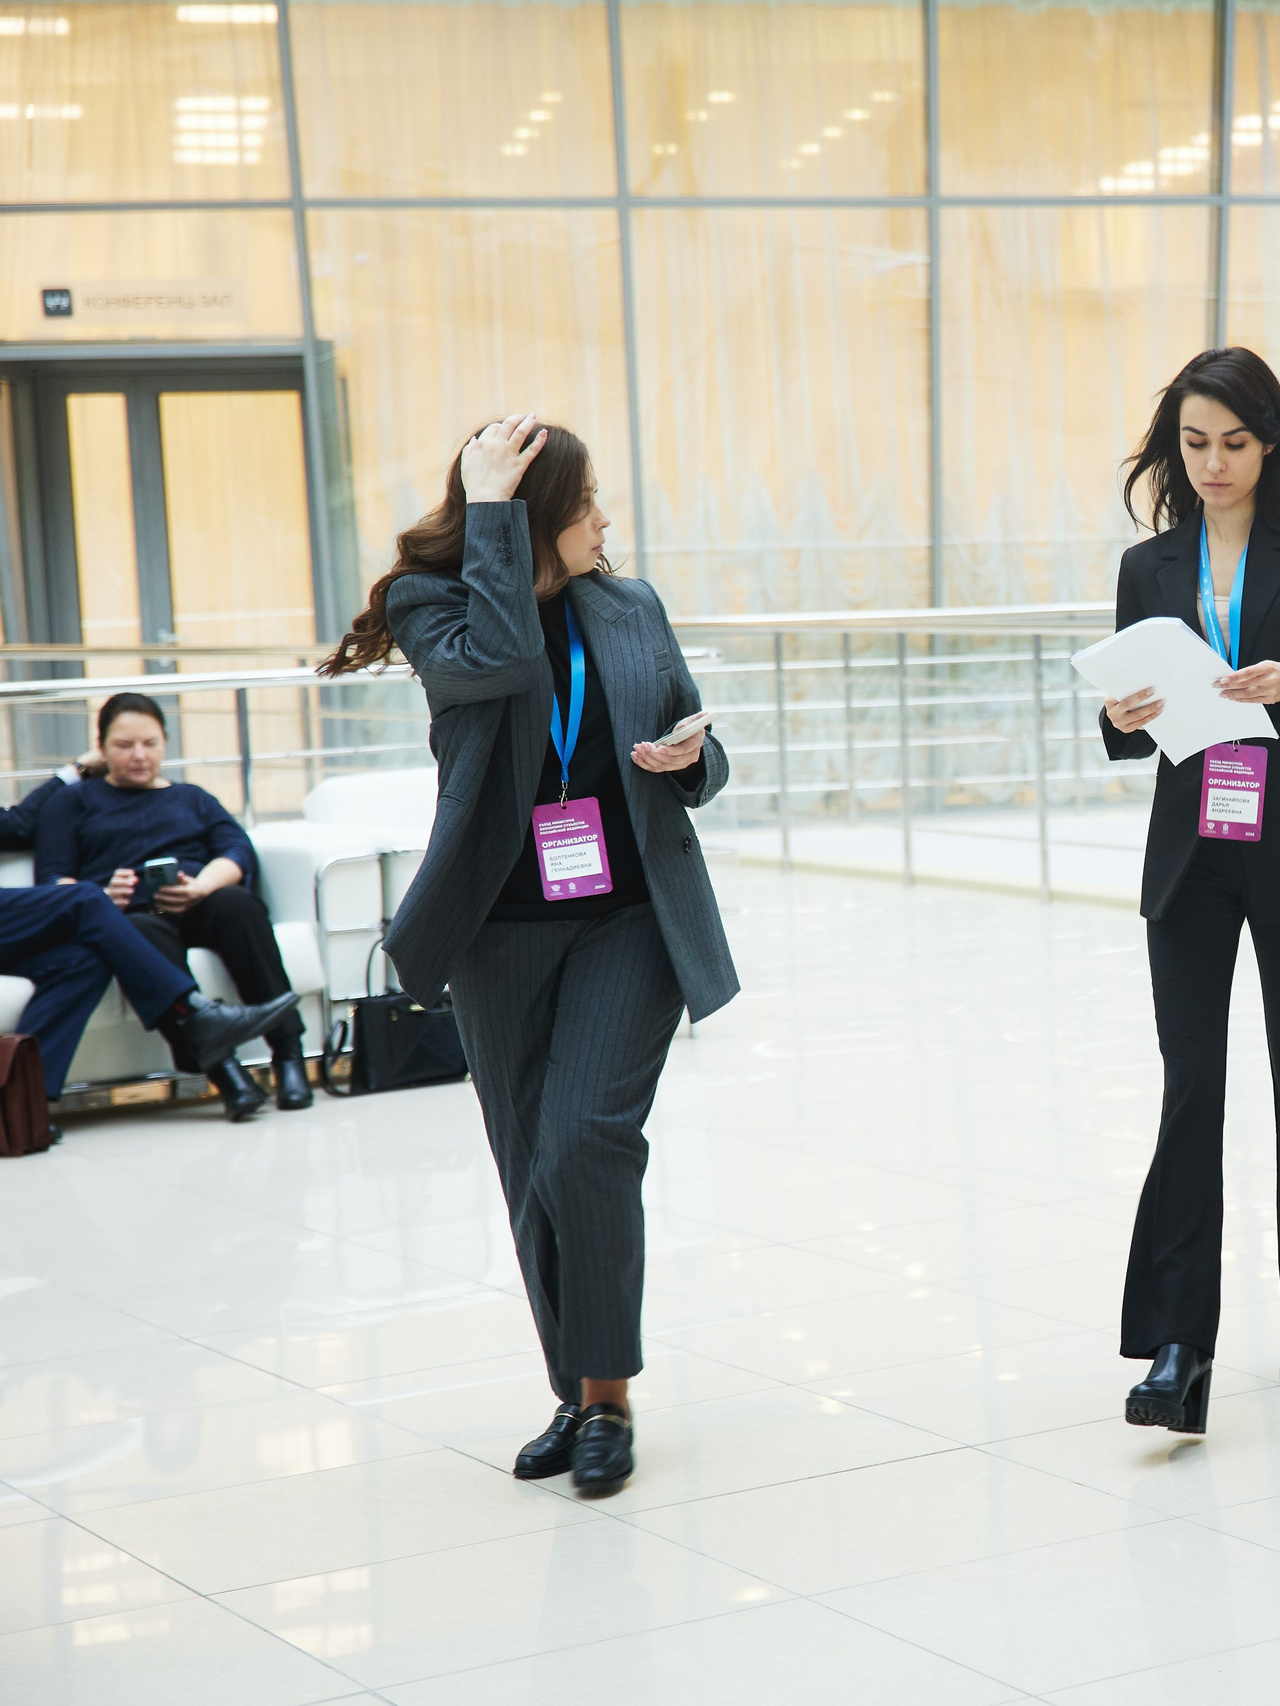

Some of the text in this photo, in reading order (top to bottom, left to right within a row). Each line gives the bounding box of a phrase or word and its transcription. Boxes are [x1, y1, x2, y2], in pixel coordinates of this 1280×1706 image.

[1208, 778, 1260, 788] ОРГАНИЗАТОР
[542, 834, 598, 848] ОРГАНИЗАТОР
[549, 851, 587, 861] БОЛТЕНКОВА
[551, 863, 592, 873] ГЕННАДИЕВНА
